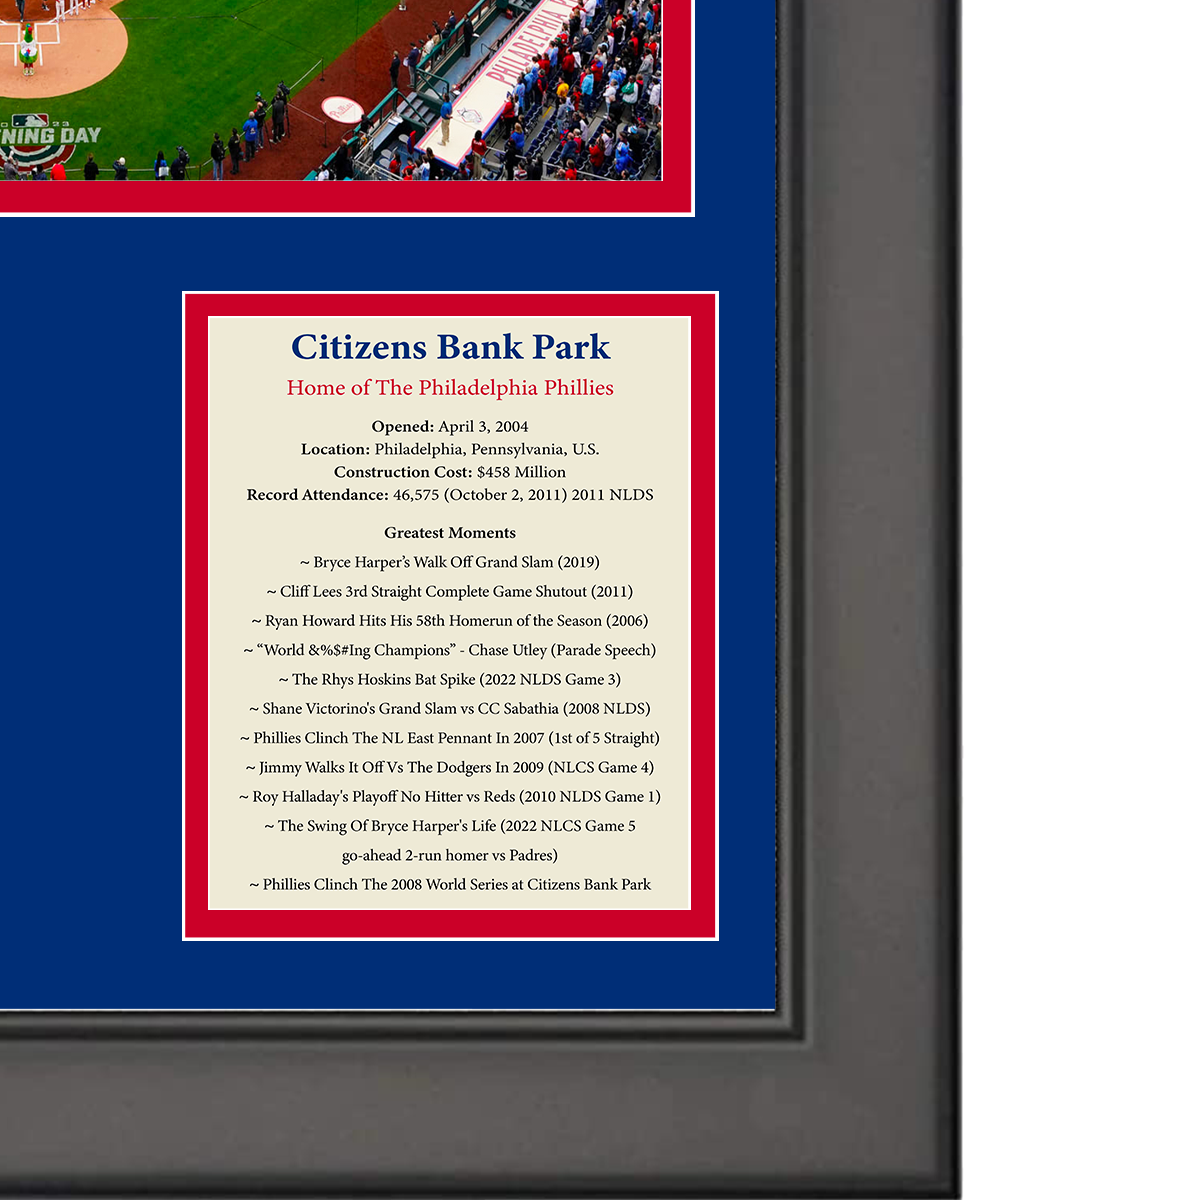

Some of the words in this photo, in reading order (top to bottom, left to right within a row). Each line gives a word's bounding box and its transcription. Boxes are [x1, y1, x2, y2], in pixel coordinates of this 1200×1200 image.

[485, 8, 568, 87] PHILADELPHIA
[60, 127, 102, 144] DAY
[291, 333, 427, 360] Citizens
[436, 332, 525, 360] Bank
[531, 332, 612, 360] Park
[286, 379, 346, 396] Home
[350, 378, 373, 396] of
[374, 378, 413, 396] The
[418, 378, 539, 402] Philadelphia
[544, 378, 614, 396] Phillies
[371, 419, 434, 437] Opened:
[437, 419, 475, 437] April
[478, 420, 491, 435] 3,
[495, 420, 529, 433] 2004
[300, 442, 370, 456] Location:
[374, 441, 467, 460] Philadelphia,
[471, 442, 568, 460] Pennsylvania,
[572, 442, 600, 456] U.S.
[333, 465, 431, 479] Construction
[433, 465, 473, 479] Cost:
[476, 465, 511, 480] $458
[514, 464, 567, 479] Million
[246, 487, 299, 501] Record
[301, 487, 389, 501] Attendance:
[392, 488, 440, 503] 46,575
[443, 487, 508, 504] (October
[511, 488, 524, 503] 2,
[527, 487, 568, 504] 2011)
[571, 488, 605, 501] 2011
[609, 488, 654, 502] NLDS
[384, 526, 445, 540] Greatest
[447, 526, 517, 539] Moments
[313, 555, 352, 573] Bryce
[354, 554, 411, 573] Harper’s
[413, 554, 448, 569] Walk
[450, 553, 474, 570] Off
[475, 553, 520, 570] Grand
[521, 554, 554, 569] Slam
[557, 554, 601, 572] (2019)
[264, 614, 299, 631] Ryan
[302, 613, 356, 627] Howard
[358, 614, 387, 627] Hits
[389, 614, 413, 627] His
[415, 613, 446, 627] 58th
[448, 614, 514, 627] Homerun
[516, 613, 532, 627] of
[532, 613, 554, 627] the
[556, 613, 603, 627] Season
[605, 613, 649, 630] (2006)
[291, 672, 319, 686] The
[321, 672, 355, 690] Rhys
[357, 672, 412, 686] Hoskins
[414, 672, 437, 686] Bat
[439, 672, 476, 690] Spike
[479, 672, 517, 689] (2022
[519, 672, 562, 686] NLDS
[564, 672, 605, 686] Game
[607, 671, 622, 689] 3)
[277, 818, 304, 832] The
[307, 819, 348, 837] Swing
[350, 818, 370, 833] Of
[371, 819, 409, 836] Bryce
[412, 818, 469, 836] Harper's
[471, 818, 497, 832] Life
[500, 818, 538, 835] (2022
[540, 819, 582, 833] NLCS
[584, 819, 625, 833] Game
[627, 819, 636, 833] 5
[341, 848, 402, 866] go-ahead
[405, 849, 442, 862] 2-run
[445, 848, 490, 862] homer
[491, 852, 506, 862] vs
[509, 847, 558, 865] Padres)
